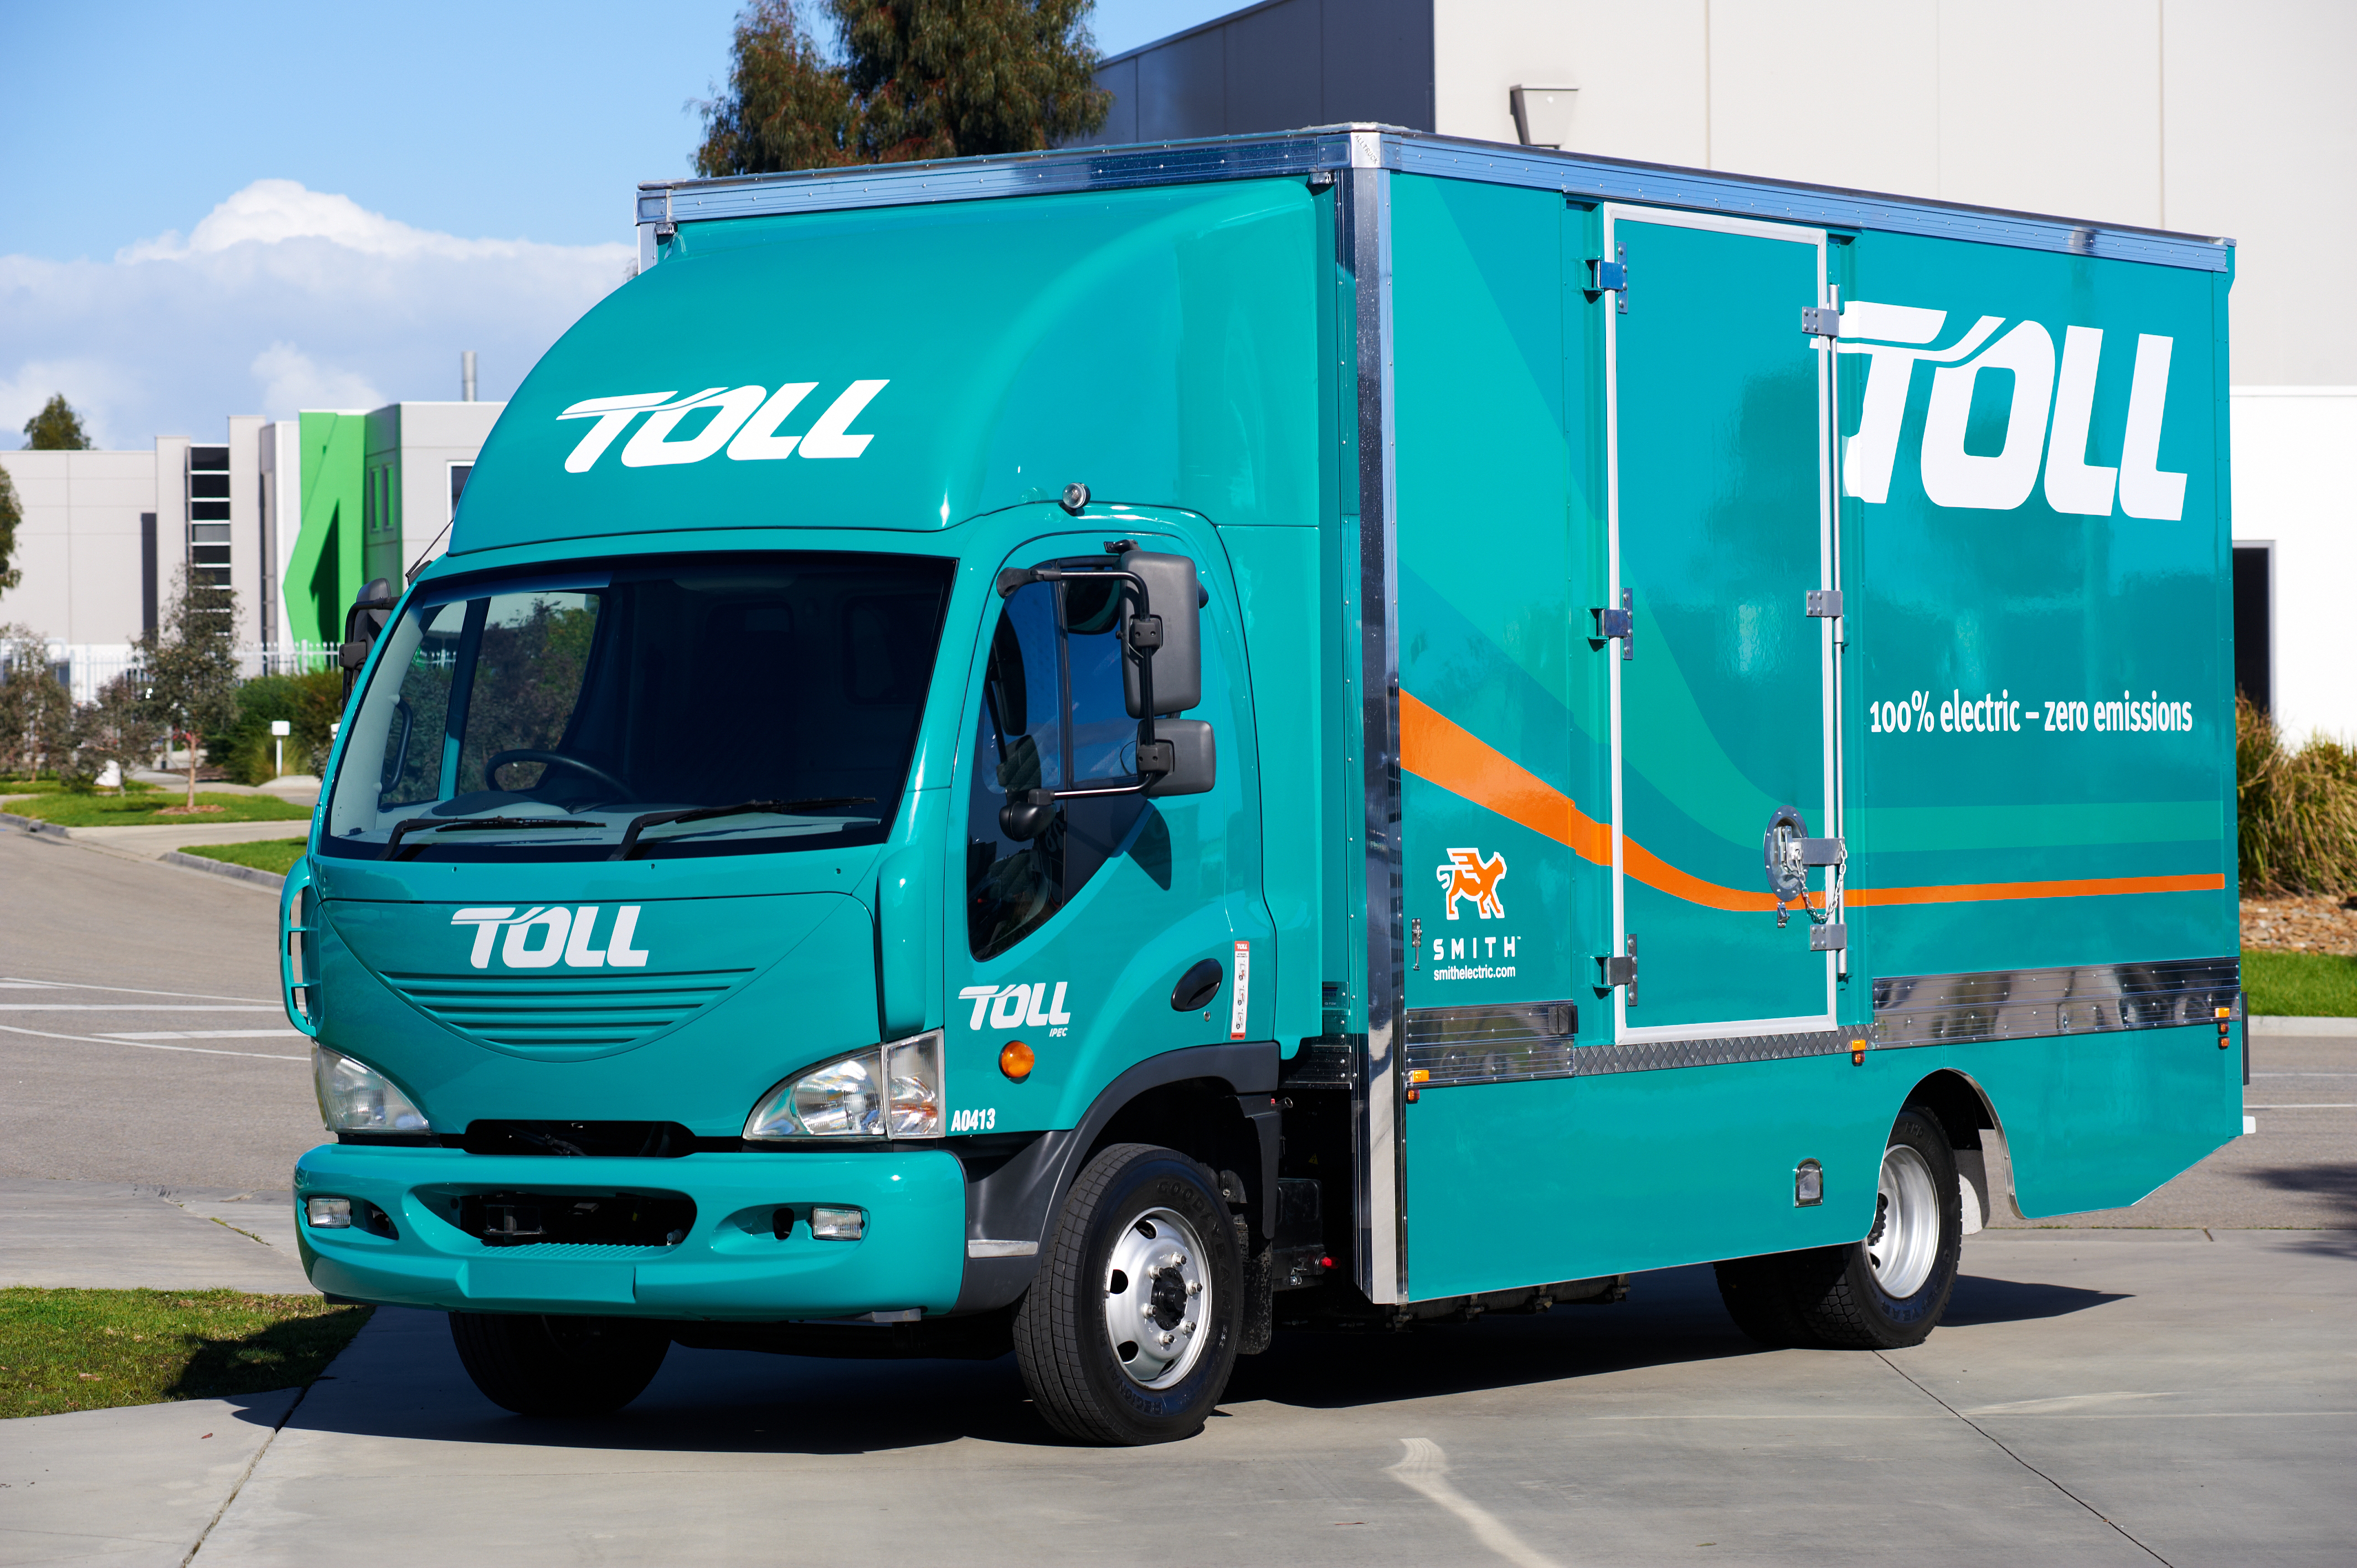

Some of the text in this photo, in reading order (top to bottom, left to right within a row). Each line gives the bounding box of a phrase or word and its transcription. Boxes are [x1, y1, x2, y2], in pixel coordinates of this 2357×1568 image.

[1355, 135, 1378, 164] ALLTRUCK
[555, 379, 891, 474] TOLL
[1809, 301, 2188, 522] TOLL
[1870, 690, 1935, 734] 100%
[1941, 689, 2021, 733] electric
[2045, 702, 2089, 732] zero
[2094, 690, 2193, 733] emissions
[451, 905, 650, 969] TOLL
[1433, 936, 1516, 961] SMITH
[1434, 964, 1516, 981] smithelectric.com
[958, 982, 1071, 1030] TOLL
[1049, 1028, 1068, 1038] IPEC
[950, 1108, 996, 1132] A0413
[1157, 1180, 1232, 1311] GOODYEAR
[1105, 1357, 1163, 1415] REGIONAL
